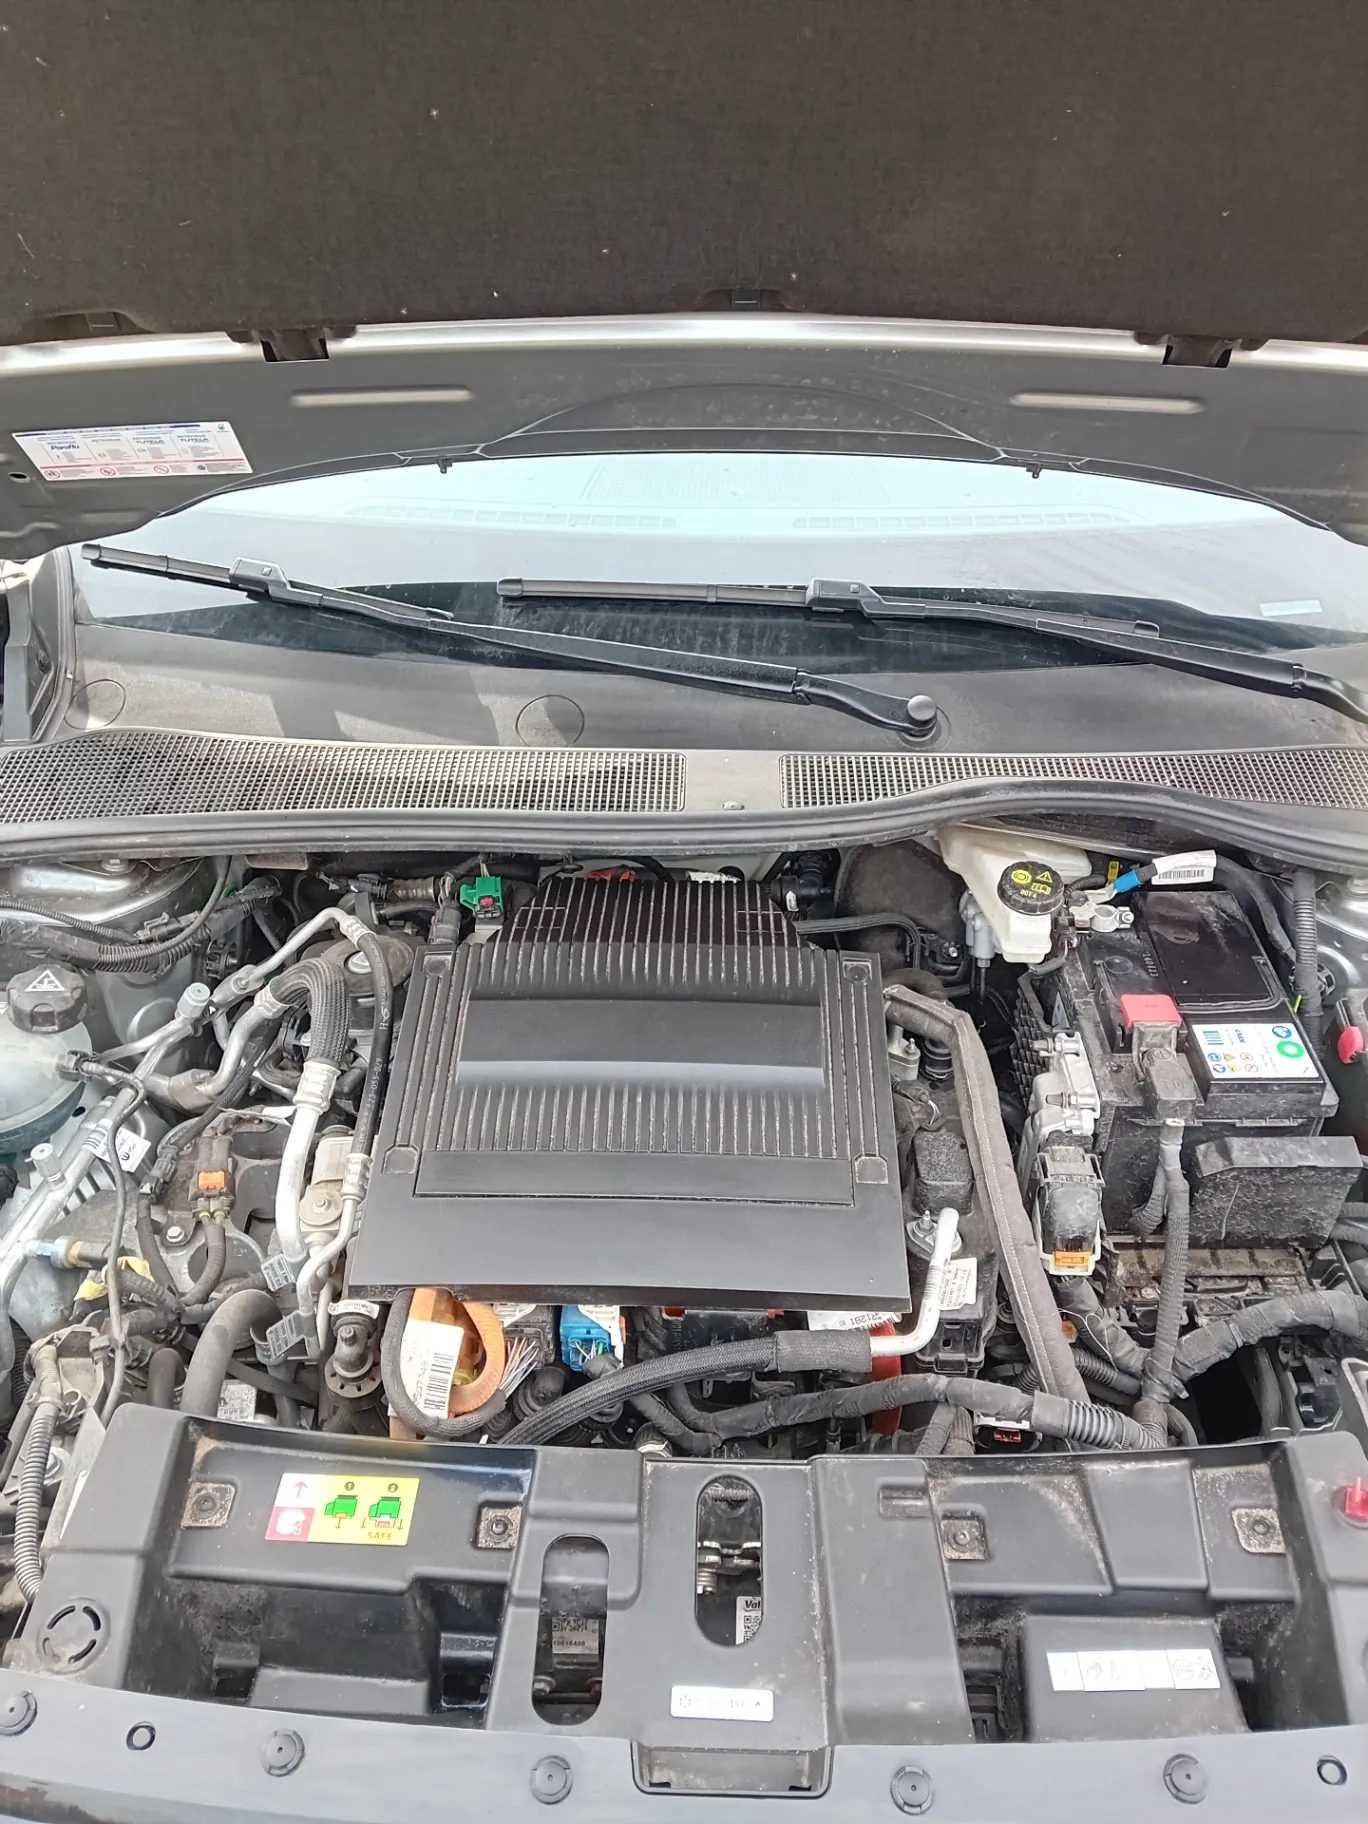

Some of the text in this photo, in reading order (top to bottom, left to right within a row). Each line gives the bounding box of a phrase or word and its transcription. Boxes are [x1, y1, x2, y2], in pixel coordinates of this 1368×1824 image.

[1020, 889, 1033, 897] DOT
[368, 1058, 383, 1104] 23-055-D29
[368, 1532, 393, 1540] SAFE
